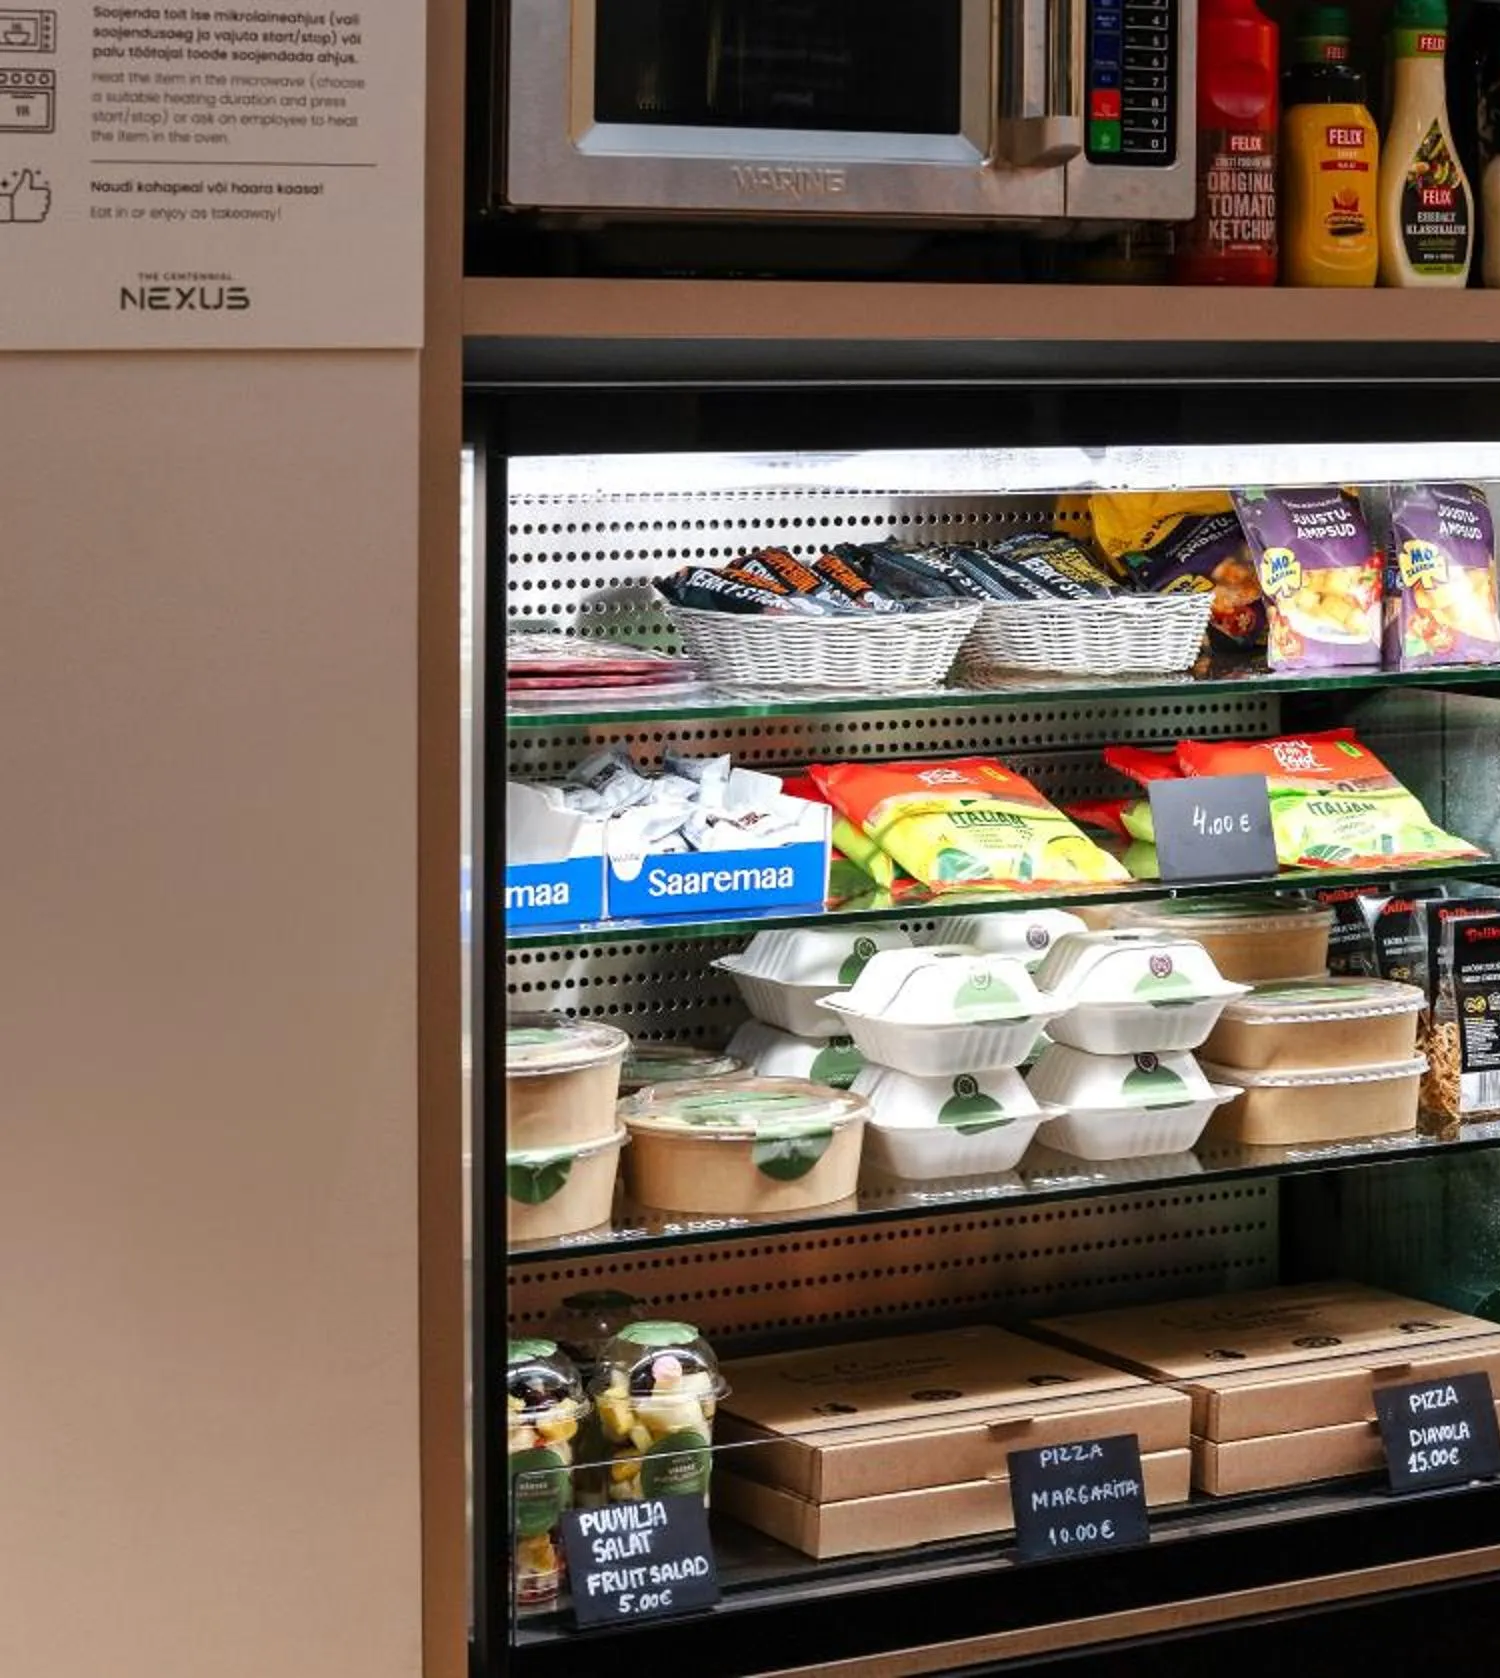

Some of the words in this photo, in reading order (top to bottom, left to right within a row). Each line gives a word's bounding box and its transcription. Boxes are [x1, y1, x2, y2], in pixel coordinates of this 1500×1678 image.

[93, 6, 160, 22] Soojenda
[164, 9, 187, 19] toit
[190, 9, 210, 20] ise
[213, 9, 325, 27] mikrolaineahjus
[93, 26, 193, 43] soojendusaeg
[197, 27, 210, 43] ja
[213, 30, 258, 45] vajuta
[93, 46, 124, 58] palu
[128, 46, 183, 61] töötajal
[187, 48, 227, 60] toode
[231, 50, 314, 64] soojendada
[91, 72, 124, 83] Heat
[128, 72, 150, 83] the
[155, 73, 185, 84] item
[189, 74, 201, 84] in
[205, 74, 227, 85] the
[231, 75, 305, 87] microwave
[1152, 77, 1160, 88] 7
[105, 92, 159, 103] suitable
[163, 93, 216, 107] heating
[219, 94, 276, 106] duration
[280, 95, 307, 107] and
[310, 97, 346, 109] press
[173, 113, 188, 124] or
[218, 114, 237, 126] an
[240, 114, 307, 129] employee
[311, 115, 324, 126] to
[327, 115, 358, 128] heat
[1151, 117, 1160, 128] 9
[91, 130, 114, 142] the
[118, 130, 149, 142] item
[152, 131, 164, 142] in
[168, 131, 191, 143] the
[1230, 135, 1262, 151] FELIX
[1329, 128, 1363, 145] FELIX
[91, 181, 133, 194] Naudi
[207, 182, 228, 195] või
[231, 183, 273, 196] haara
[1206, 170, 1275, 192] ORIGINAL
[1208, 193, 1275, 218] TOMATO
[1422, 188, 1453, 205] FELIX
[91, 206, 112, 219] Eat
[115, 206, 128, 219] in
[149, 208, 186, 223] enjoy
[120, 287, 250, 310] NEXUS
[1297, 523, 1356, 540] AMPSUD
[649, 865, 795, 898] Saaremaa
[1408, 1385, 1459, 1414] PIZZA
[1409, 1421, 1471, 1448] DIAVOLA
[1039, 1444, 1104, 1469] PIZZA
[579, 1501, 668, 1537] PUUVILJA
[592, 1529, 654, 1564] SALAT
[586, 1568, 646, 1597] FRUIT
[650, 1555, 710, 1584] SALAD
